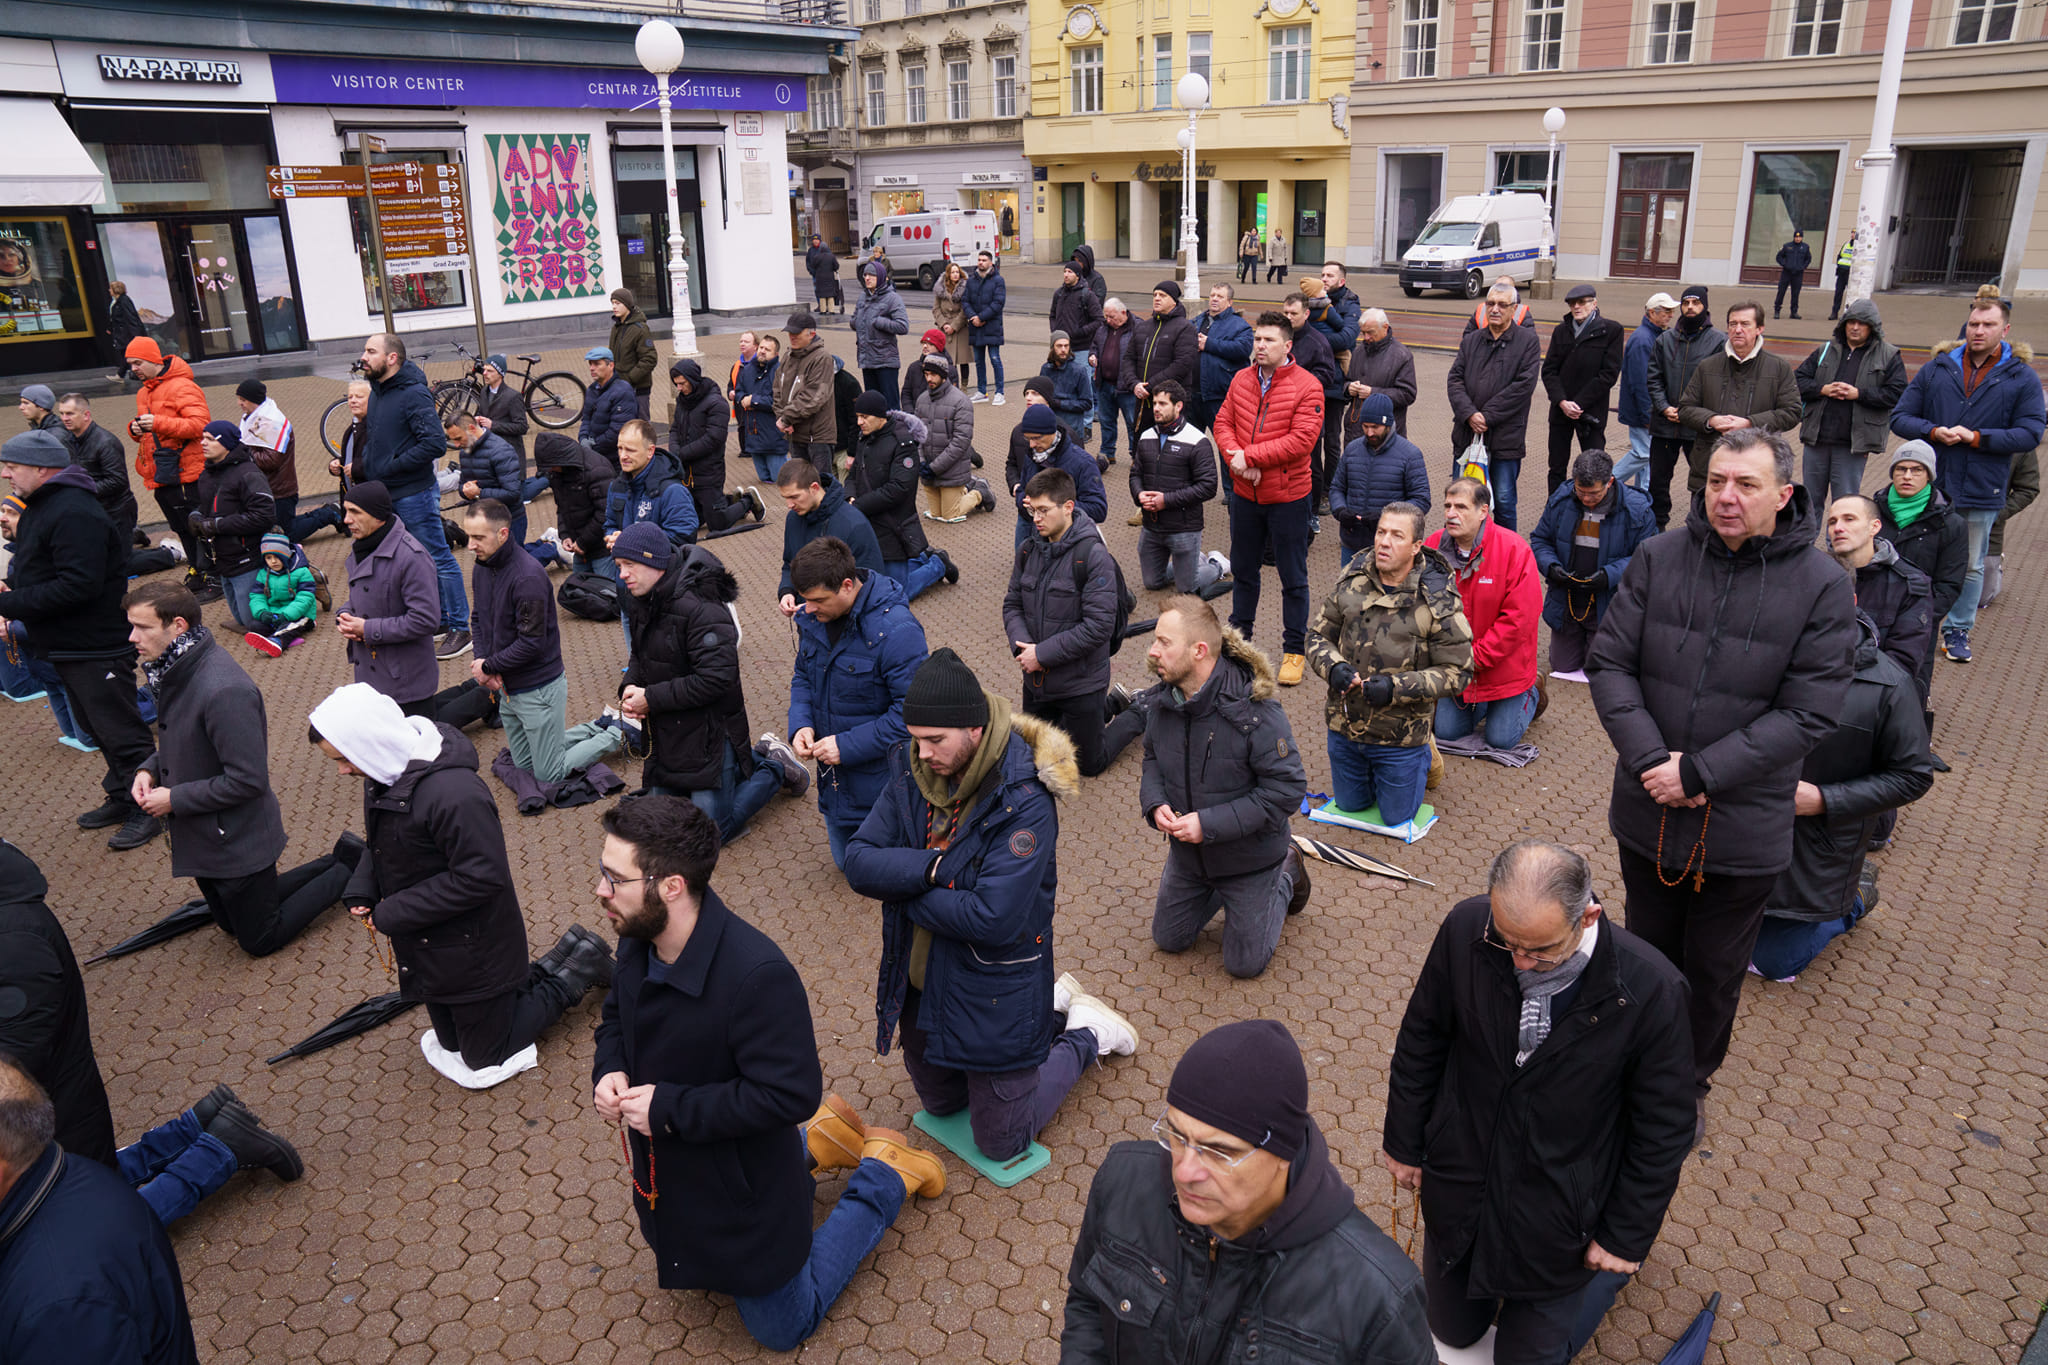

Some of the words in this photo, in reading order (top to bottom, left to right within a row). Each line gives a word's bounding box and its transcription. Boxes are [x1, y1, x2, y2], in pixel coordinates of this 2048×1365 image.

[103, 57, 240, 82] NAPAPIJRI
[331, 74, 399, 88] VISITOR
[405, 77, 465, 91] CENTER
[588, 82, 638, 95] CENTAR
[642, 84, 658, 96] ZA
[670, 84, 742, 98] OSJETITELJE
[504, 144, 578, 181] ADV
[618, 162, 652, 171] VISITOR
[510, 182, 579, 217] ENT
[512, 218, 586, 256] ZAG
[1505, 251, 1526, 261] POLICIJA
[197, 272, 235, 292] SALE
